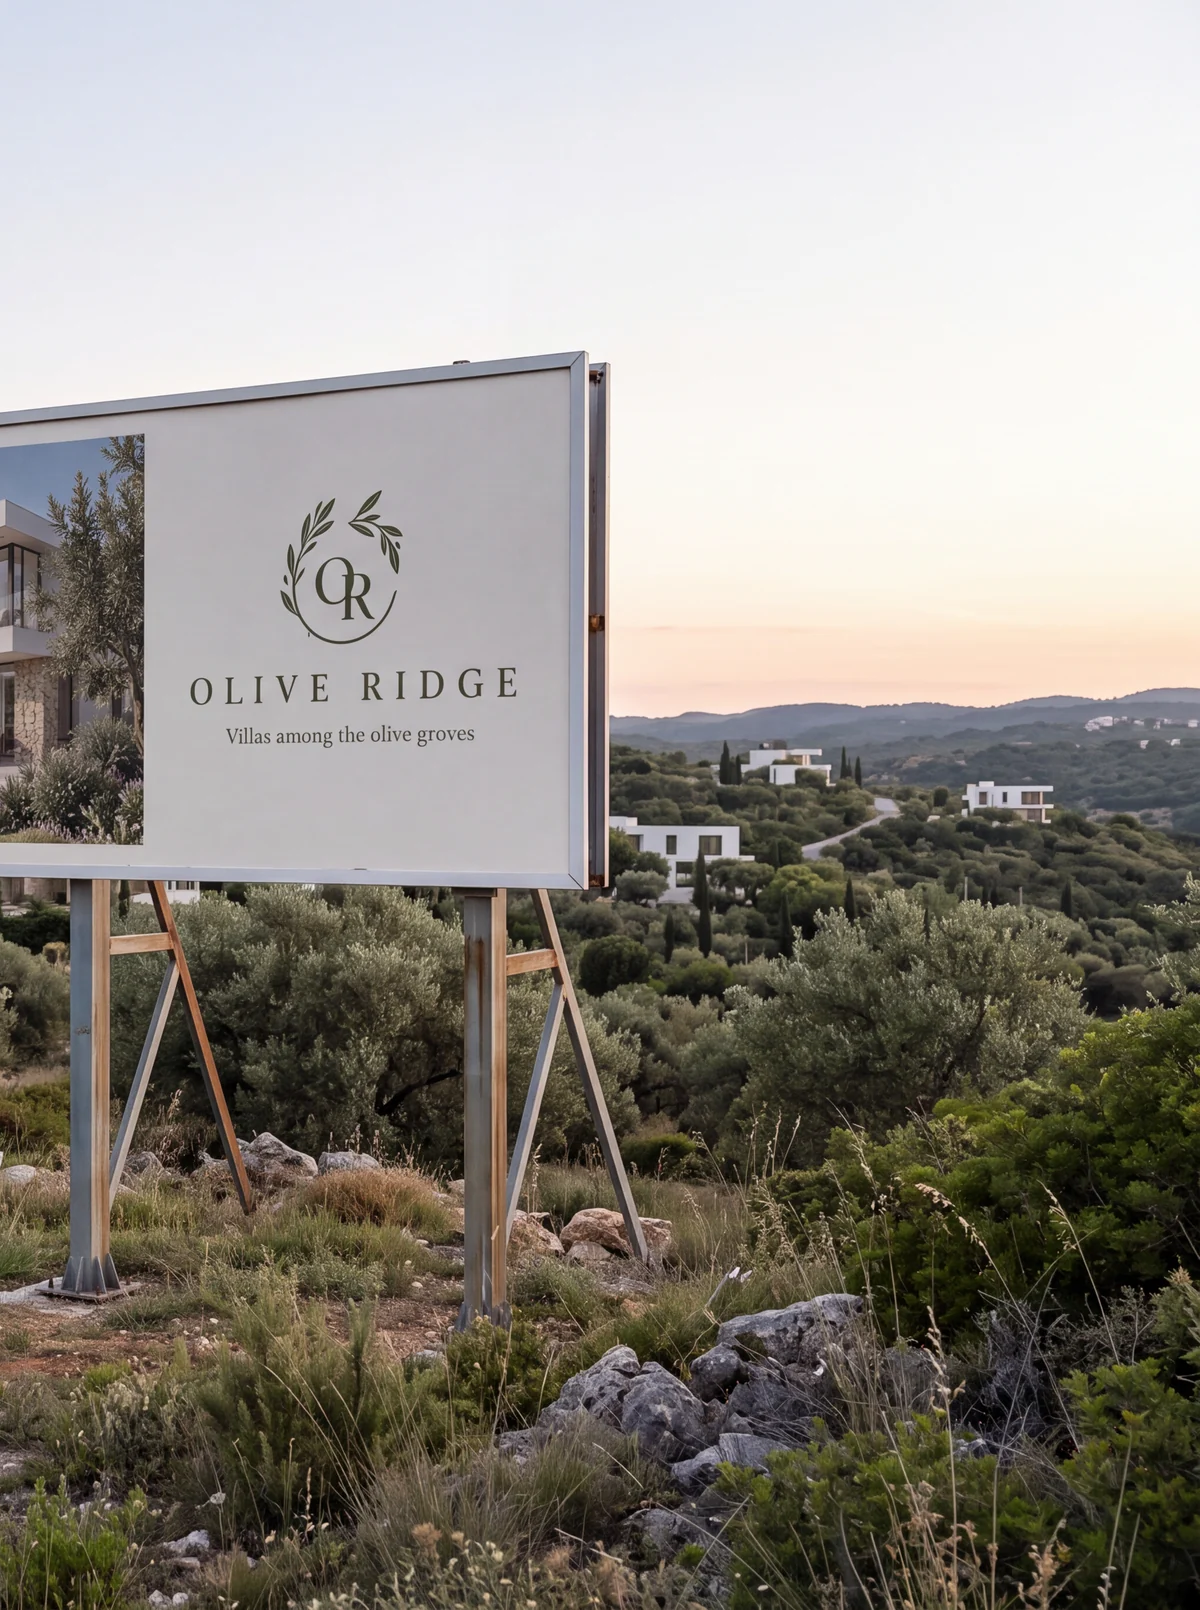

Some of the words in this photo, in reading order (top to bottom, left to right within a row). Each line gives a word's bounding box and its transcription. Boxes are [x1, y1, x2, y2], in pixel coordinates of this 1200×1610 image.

[314, 556, 376, 621] OR
[189, 673, 330, 706] OLIVE
[360, 667, 518, 701] RIDGE
[225, 727, 271, 745] Villas
[276, 731, 334, 749] among
[338, 725, 365, 743] the
[370, 724, 412, 743] olive
[416, 728, 476, 748] groves
